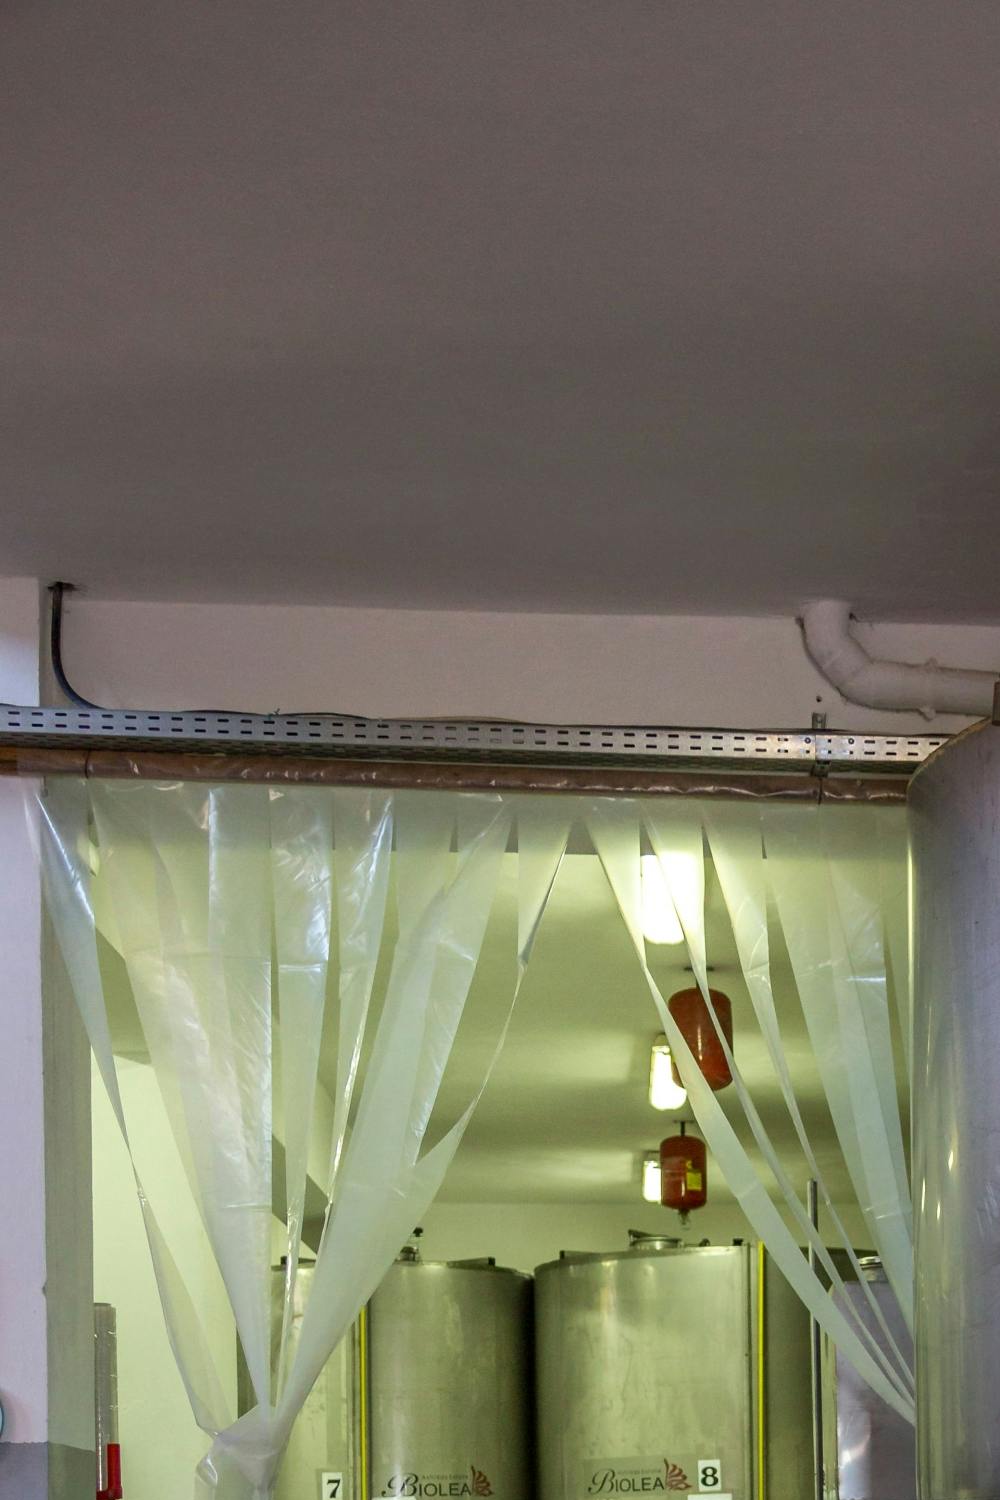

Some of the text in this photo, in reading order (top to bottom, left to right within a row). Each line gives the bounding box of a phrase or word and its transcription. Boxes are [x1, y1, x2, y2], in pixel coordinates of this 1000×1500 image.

[381, 1472, 472, 1498] BIOLEA
[588, 1468, 665, 1494] BIOLEA
[701, 1466, 719, 1487] 8
[326, 1478, 341, 1499] 7
